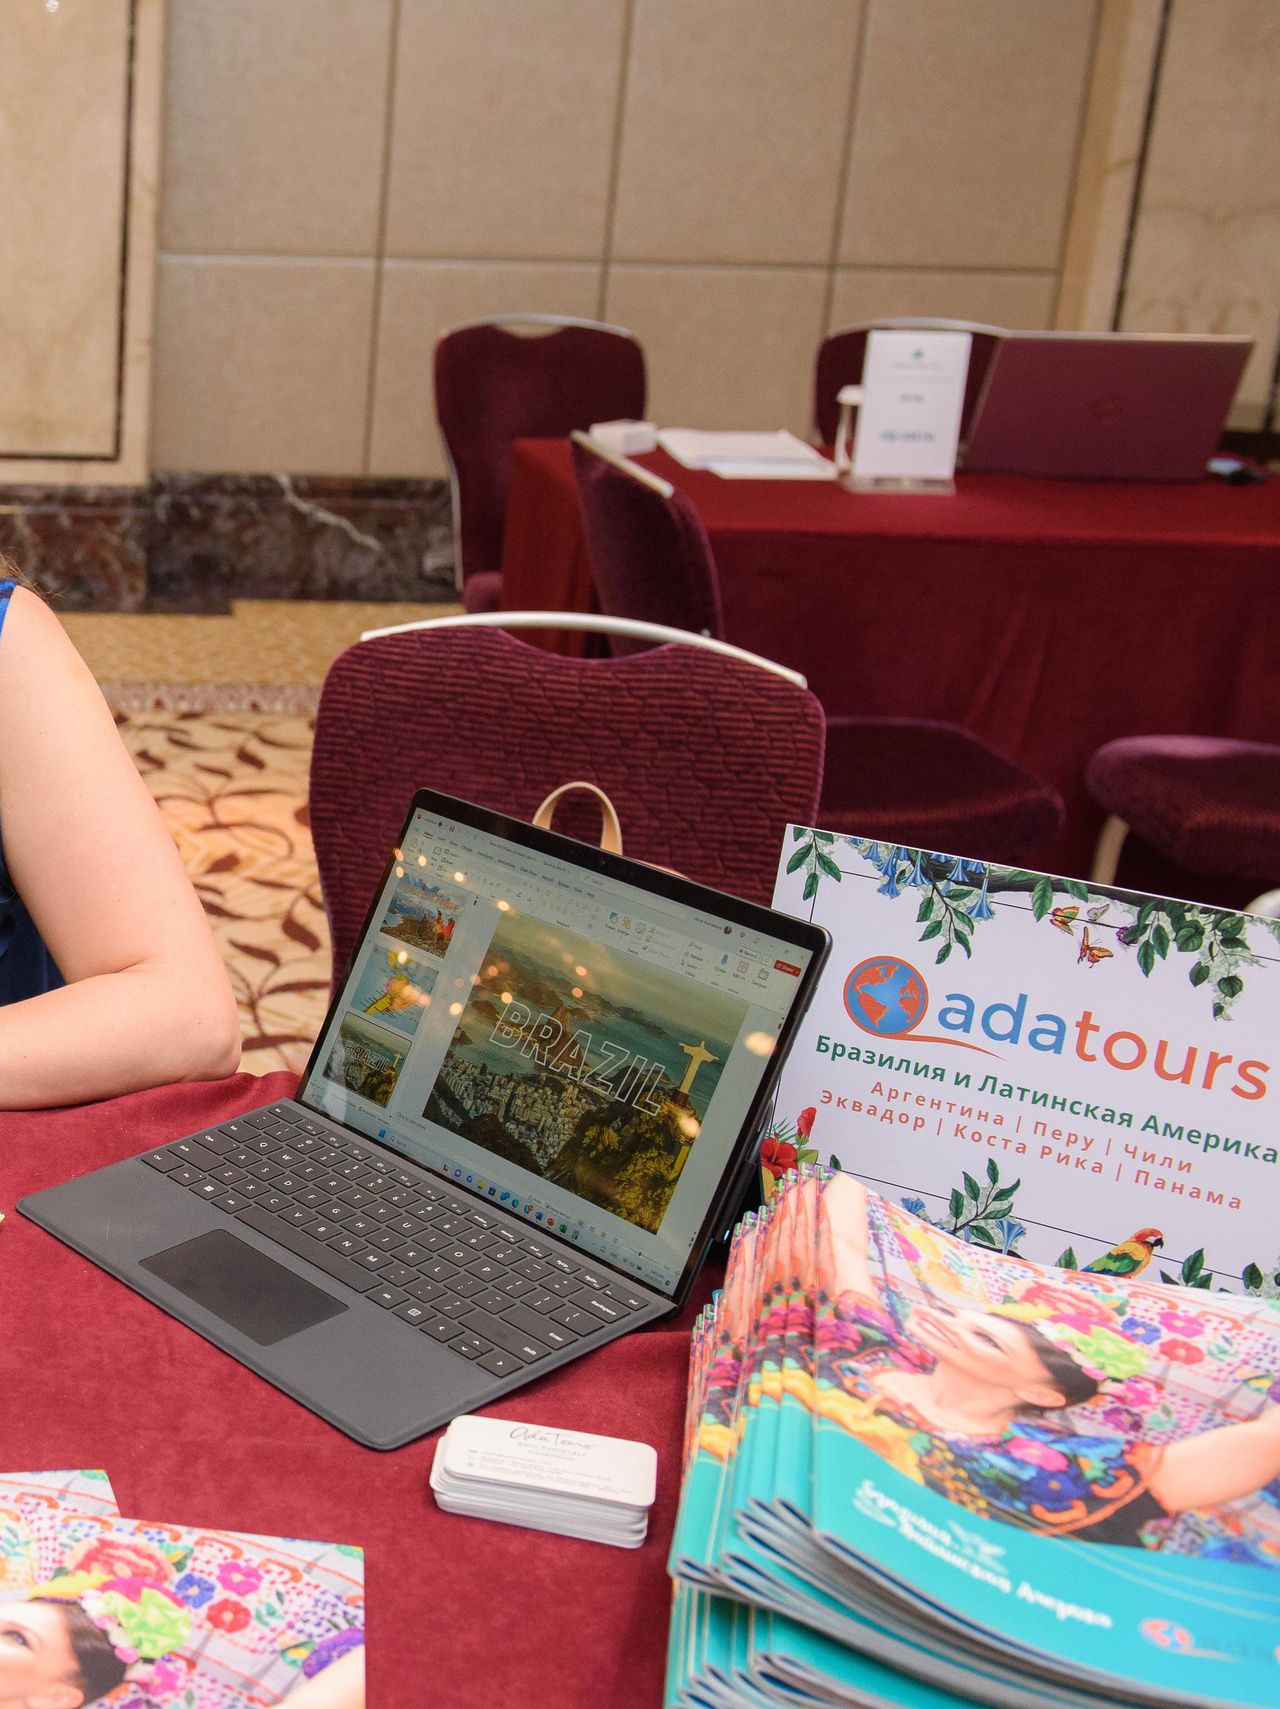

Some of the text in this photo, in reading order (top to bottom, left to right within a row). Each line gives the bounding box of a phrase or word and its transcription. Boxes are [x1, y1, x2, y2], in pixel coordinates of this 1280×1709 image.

[401, 883, 426, 898] PLACES
[435, 897, 459, 912] POWER
[744, 950, 758, 959] Record
[782, 964, 794, 973] Share
[751, 979, 768, 989] Designer
[344, 1040, 391, 1074] BRAZIL
[489, 1000, 666, 1117] BRAZIL
[937, 992, 1271, 1101] adatours
[815, 1034, 1279, 1164] Бразилия и Латинская Америка
[870, 1081, 1004, 1127] Аргентина
[1033, 1120, 1095, 1151] Перу
[1123, 1142, 1193, 1174] Чили
[820, 1089, 926, 1132] Эквадор
[954, 1123, 1028, 1155] Коста
[1039, 1144, 1104, 1174] Рика
[1134, 1169, 1243, 1210] Панама
[591, 1301, 616, 1316] Backspace
[549, 1333, 563, 1342] Enter
